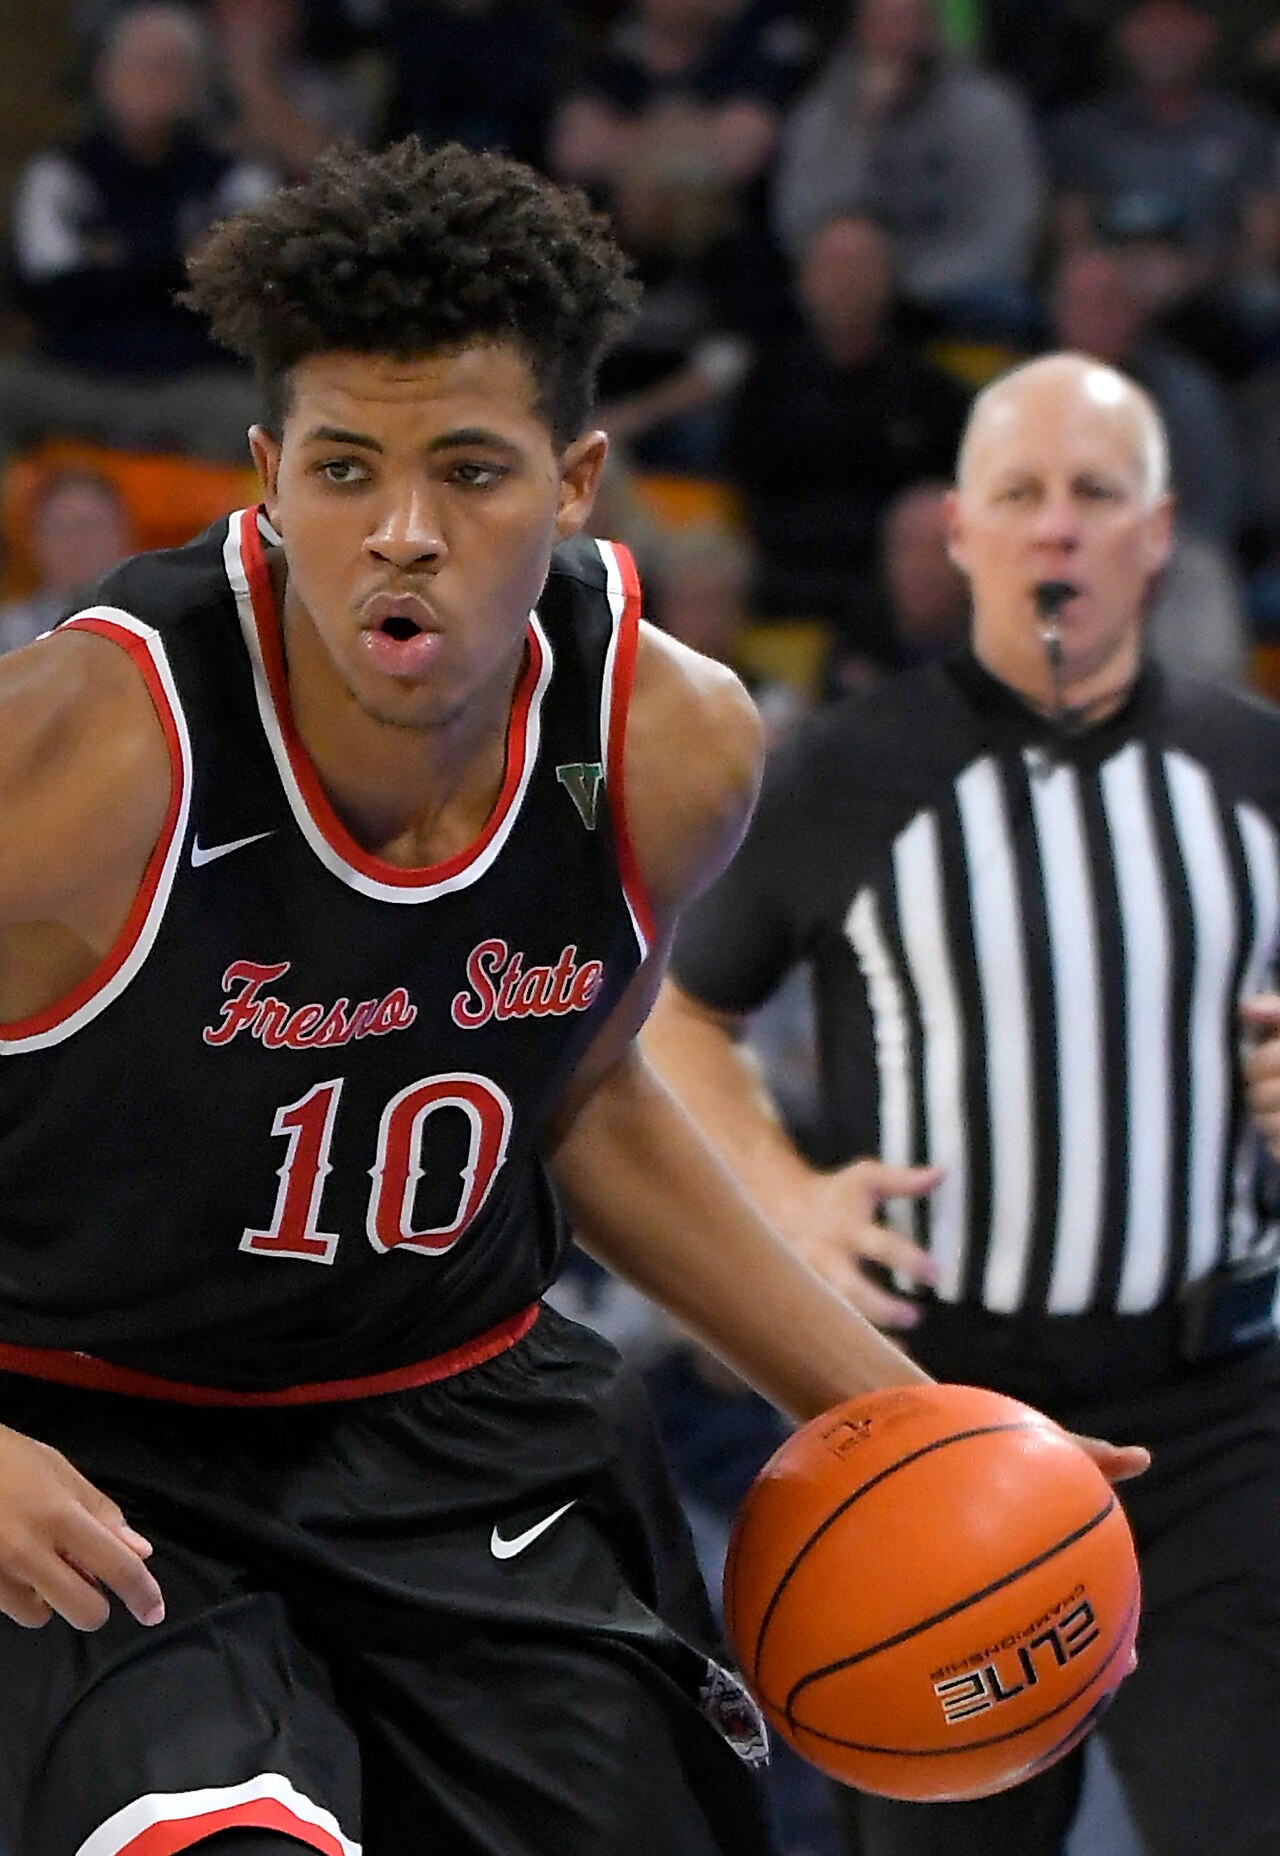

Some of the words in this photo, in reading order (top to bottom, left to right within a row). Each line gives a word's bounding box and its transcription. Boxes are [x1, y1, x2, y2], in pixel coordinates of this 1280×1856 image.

[556, 762, 604, 830] V
[203, 959, 417, 1049] Fresno
[451, 938, 604, 1030] State
[238, 1071, 513, 1266] 10
[933, 1597, 1101, 1725] ELITE
